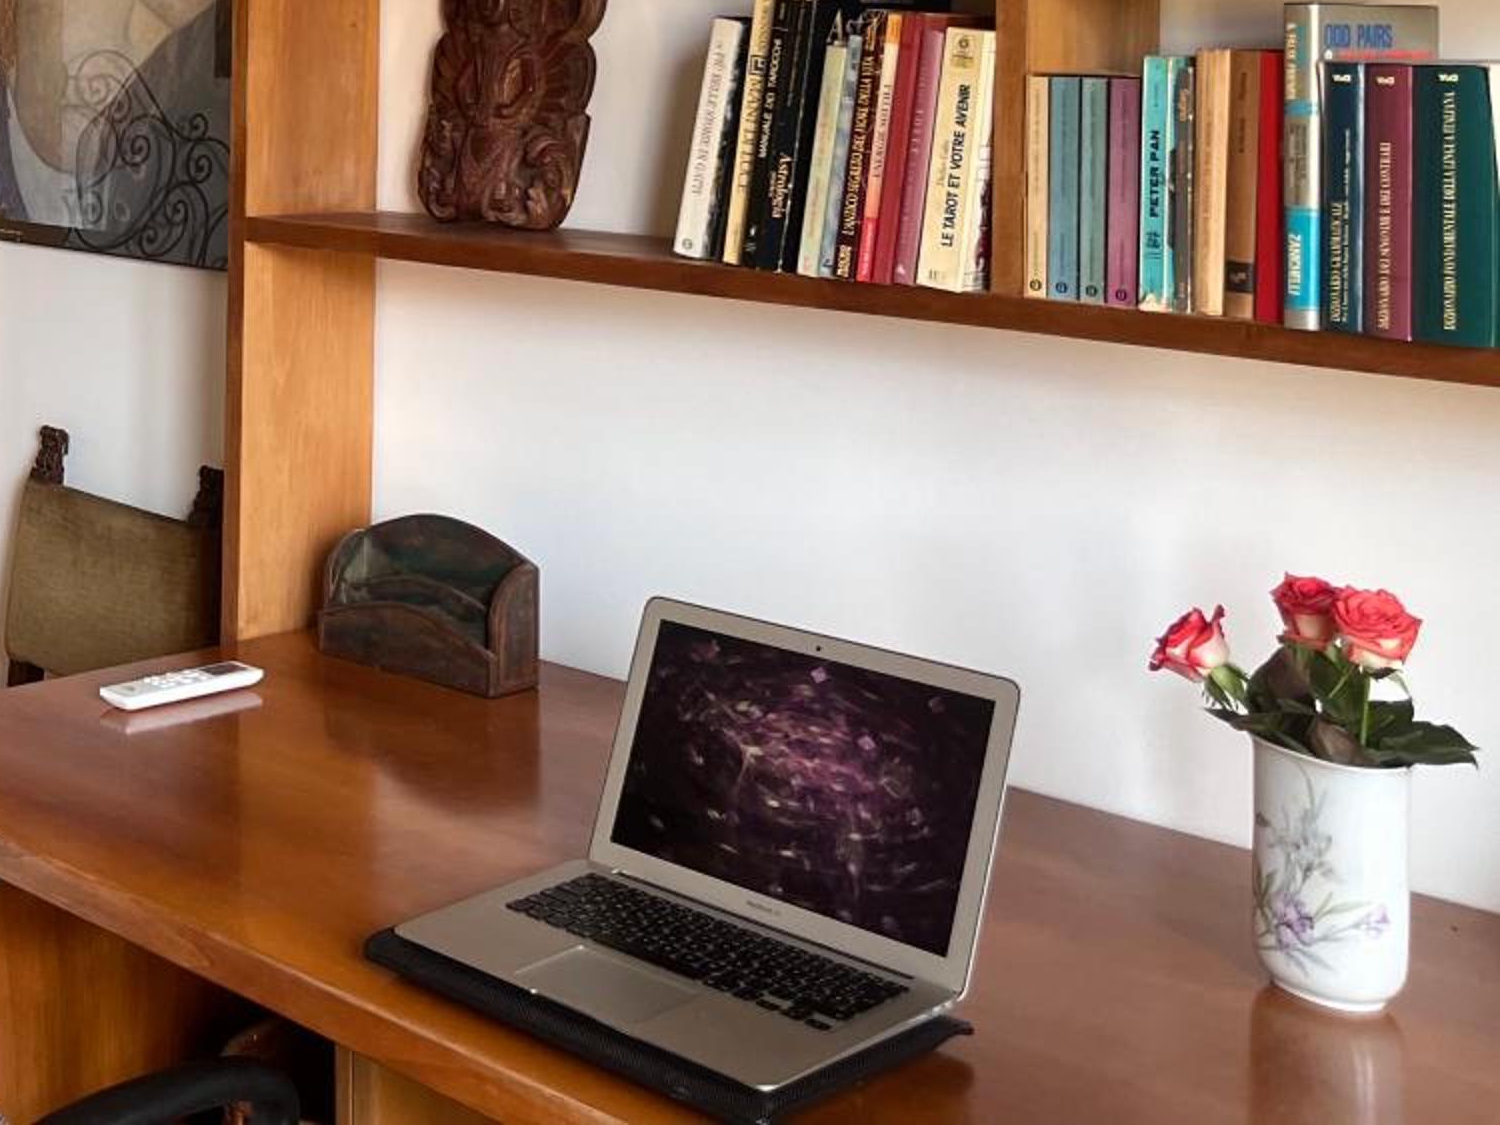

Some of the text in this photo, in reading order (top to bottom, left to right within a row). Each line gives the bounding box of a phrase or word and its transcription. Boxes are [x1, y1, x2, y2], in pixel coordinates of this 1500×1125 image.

[1357, 23, 1393, 49] PAIRS
[758, 112, 773, 159] MANUALE
[767, 38, 784, 88] TAROCCHI
[871, 129, 886, 178] ENERGIE
[940, 83, 971, 248] LE TAROT ET VOTRE AVENIR
[1148, 129, 1161, 163] PAN
[1379, 142, 1392, 189] CONTRARI
[771, 152, 795, 219] Astrologia
[1148, 167, 1161, 219] PETER
[1380, 189, 1392, 207] DEI
[1442, 92, 1456, 331] DIZIONARIO FONDAMENTALE DELLA LINGUA ITALIANA
[1379, 215, 1392, 257] SINONIMI
[1288, 233, 1302, 296] ZANICHELLI
[1328, 202, 1342, 323] DIZIONARIO GRAMMATICALE
[1378, 257, 1391, 275] DEI
[1376, 275, 1391, 330] DIZIONARIO
